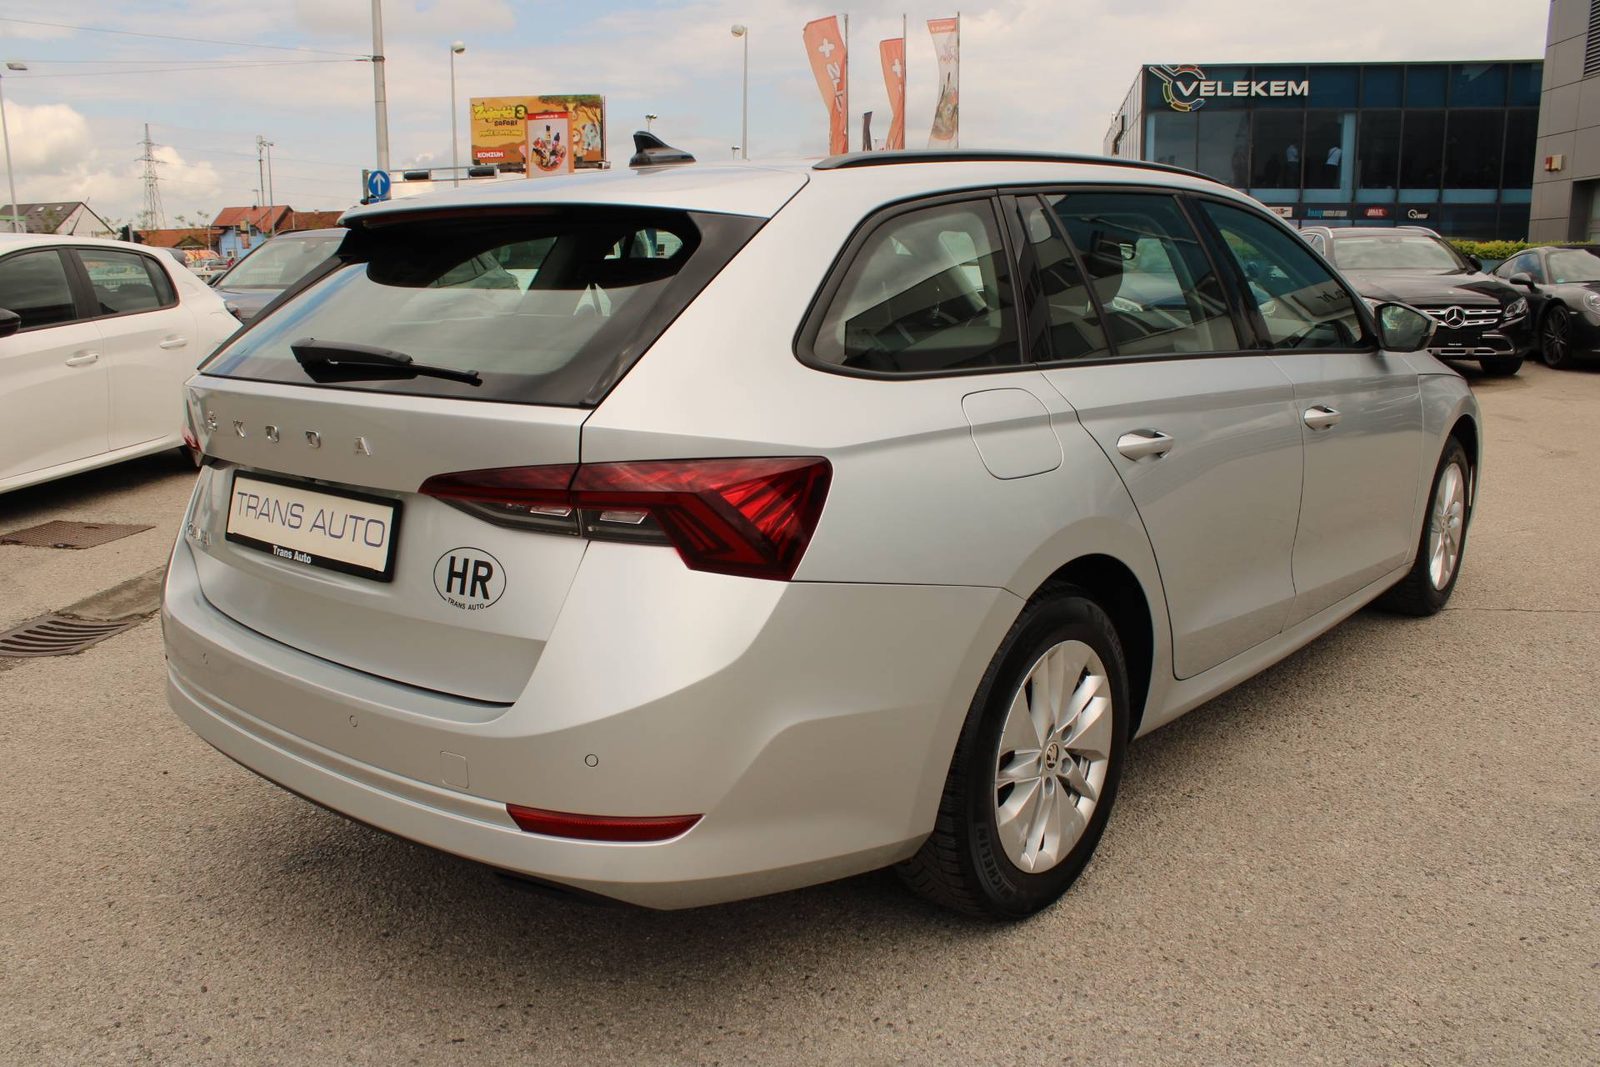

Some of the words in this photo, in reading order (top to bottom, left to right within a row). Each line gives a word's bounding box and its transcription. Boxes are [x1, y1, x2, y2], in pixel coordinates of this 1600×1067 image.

[1176, 80, 1309, 97] VELEKEM
[237, 492, 304, 529] TRANS
[309, 508, 386, 547] AUTO
[273, 546, 292, 558] Trans
[293, 551, 312, 563] Auto
[446, 556, 493, 599] HR
[448, 597, 466, 610] TRANS
[467, 603, 485, 611] AUTO
